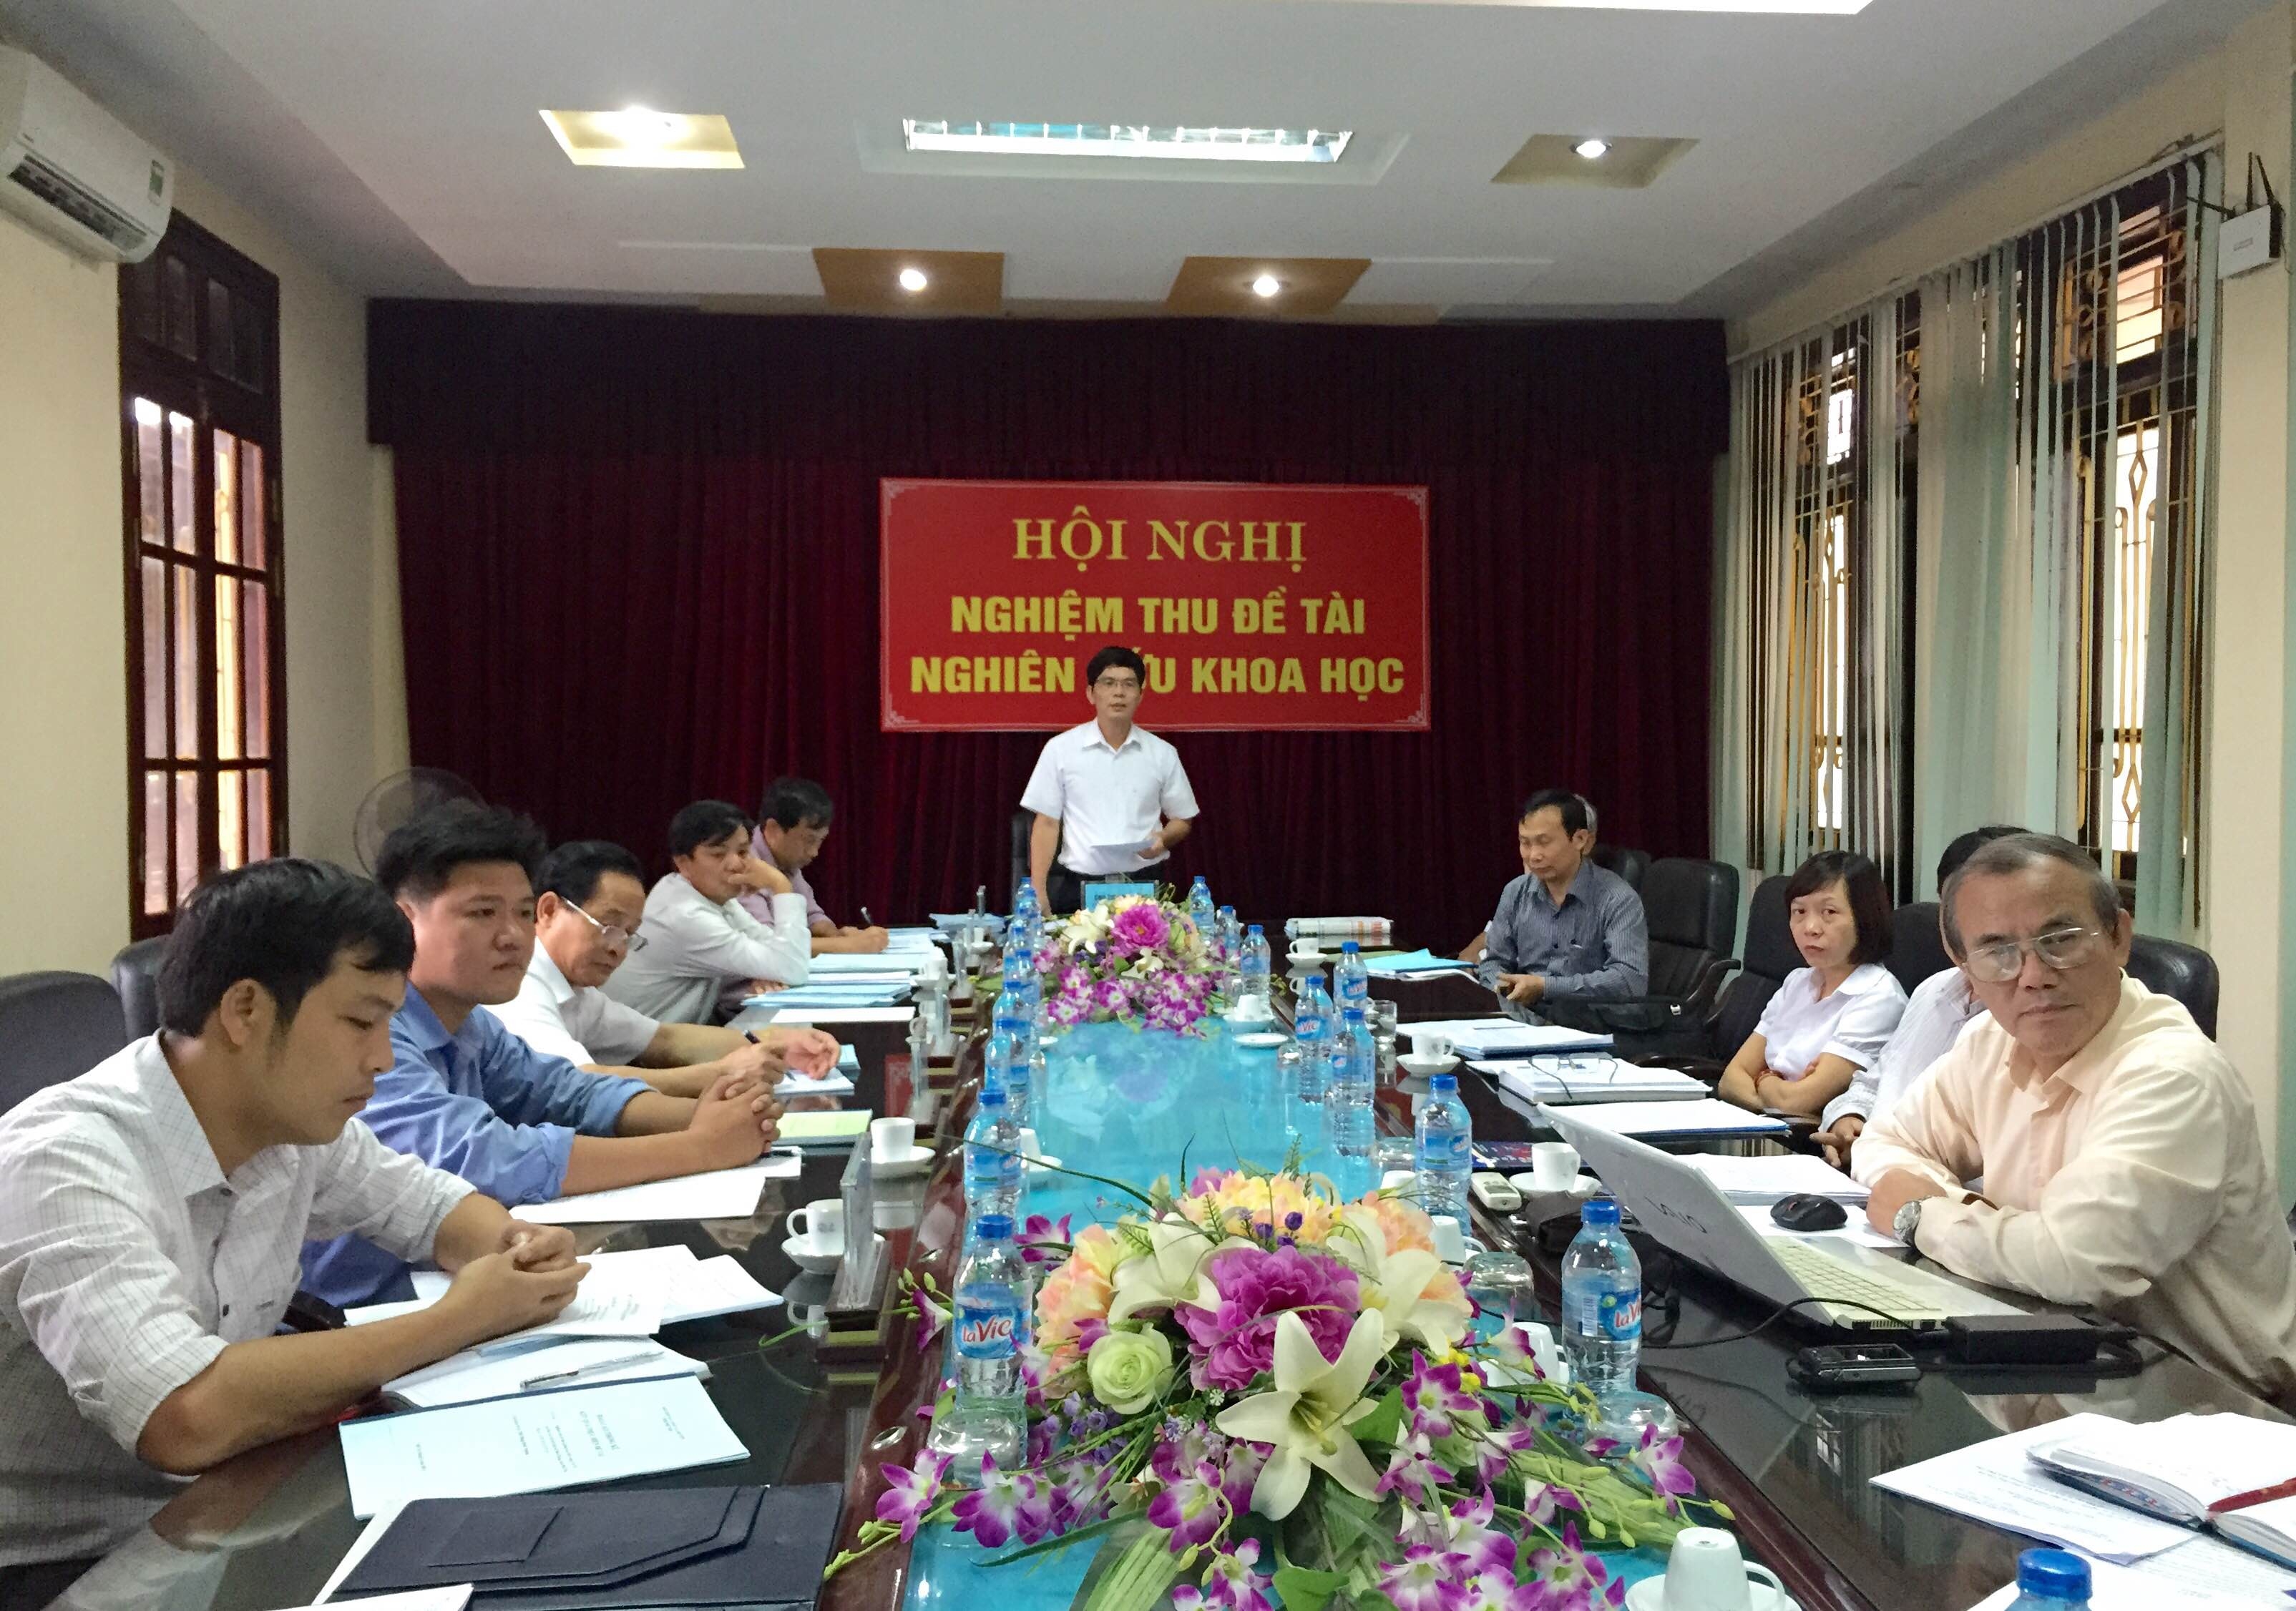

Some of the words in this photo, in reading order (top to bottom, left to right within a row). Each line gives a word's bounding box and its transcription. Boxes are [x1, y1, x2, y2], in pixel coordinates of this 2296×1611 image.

[1012, 505, 1128, 572] HỘI
[1146, 520, 1306, 573] NGHỊ
[951, 589, 1123, 641] NGHIỆM
[1138, 597, 1218, 634] THU
[1231, 585, 1286, 634] ĐỀ
[1300, 591, 1365, 635] TÀI
[910, 649, 1075, 693] NGHIÊN
[1191, 657, 1306, 693] KHOA
[1320, 657, 1405, 701] HỌC
